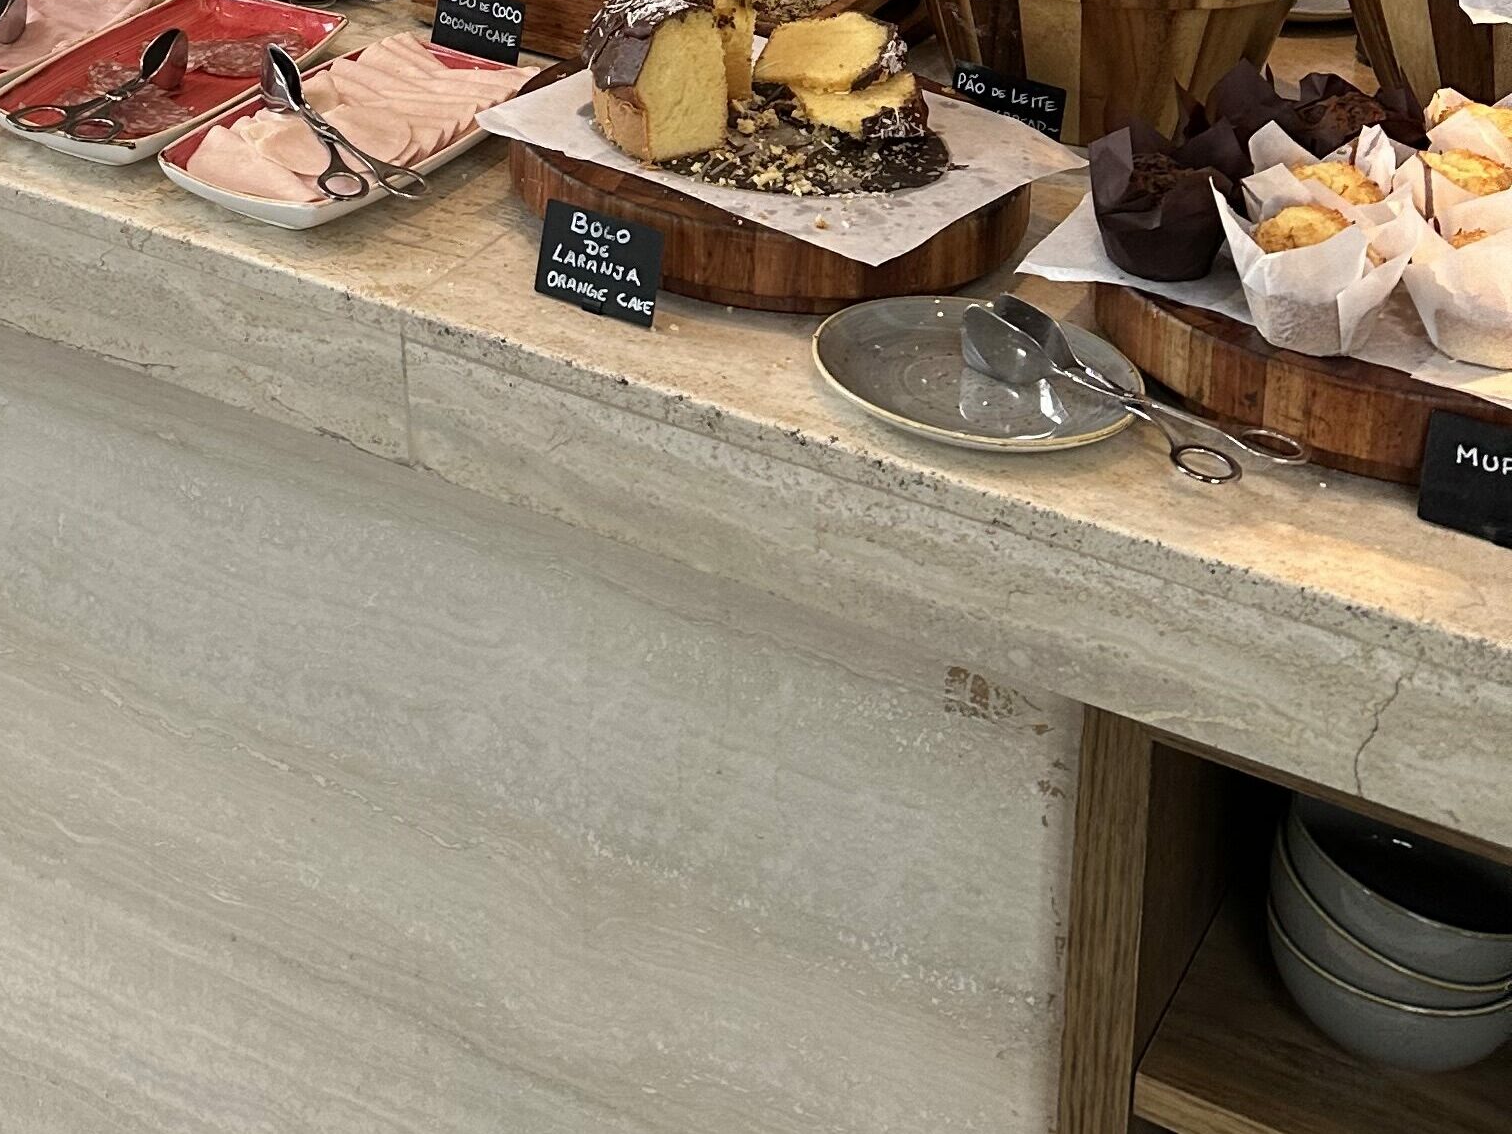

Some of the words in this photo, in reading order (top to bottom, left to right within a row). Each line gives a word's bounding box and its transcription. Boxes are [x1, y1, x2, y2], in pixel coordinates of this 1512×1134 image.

[439, 11, 489, 37] COCONUT
[485, 29, 518, 47] CAKE
[479, 1, 491, 13] DE
[492, 2, 522, 24] COCO
[957, 72, 986, 95] PÃO
[991, 87, 1007, 99] DE
[1011, 88, 1058, 112] LEITE
[570, 211, 631, 245] BOLO
[551, 242, 641, 287] LARANJA
[583, 239, 609, 258] DE
[547, 270, 609, 302] ORANGE
[616, 292, 655, 315] CAKE
